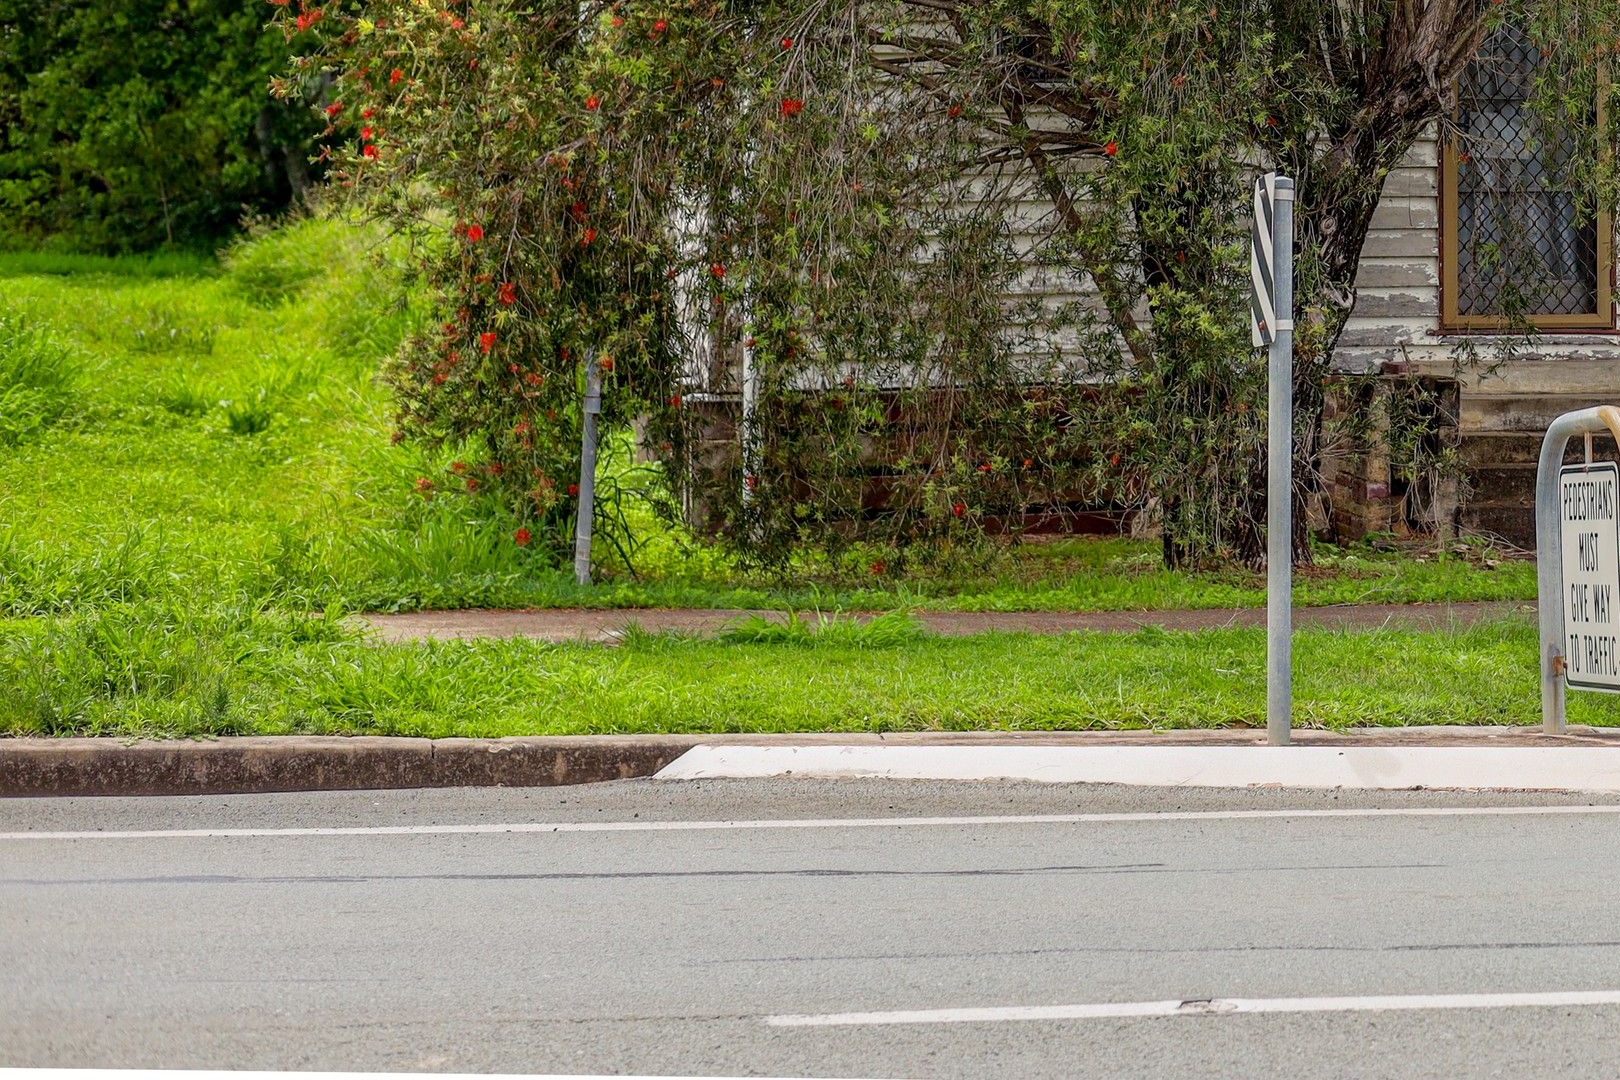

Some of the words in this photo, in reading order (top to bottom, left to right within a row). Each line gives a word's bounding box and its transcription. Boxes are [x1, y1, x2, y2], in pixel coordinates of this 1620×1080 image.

[1563, 479, 1613, 520] PEDESTRIANS
[1578, 532, 1599, 571] MUST
[1571, 584, 1589, 623] GIVE
[1593, 584, 1611, 623] WAY
[1570, 634, 1580, 673] TO
[1584, 634, 1618, 676] TRAFFIC
